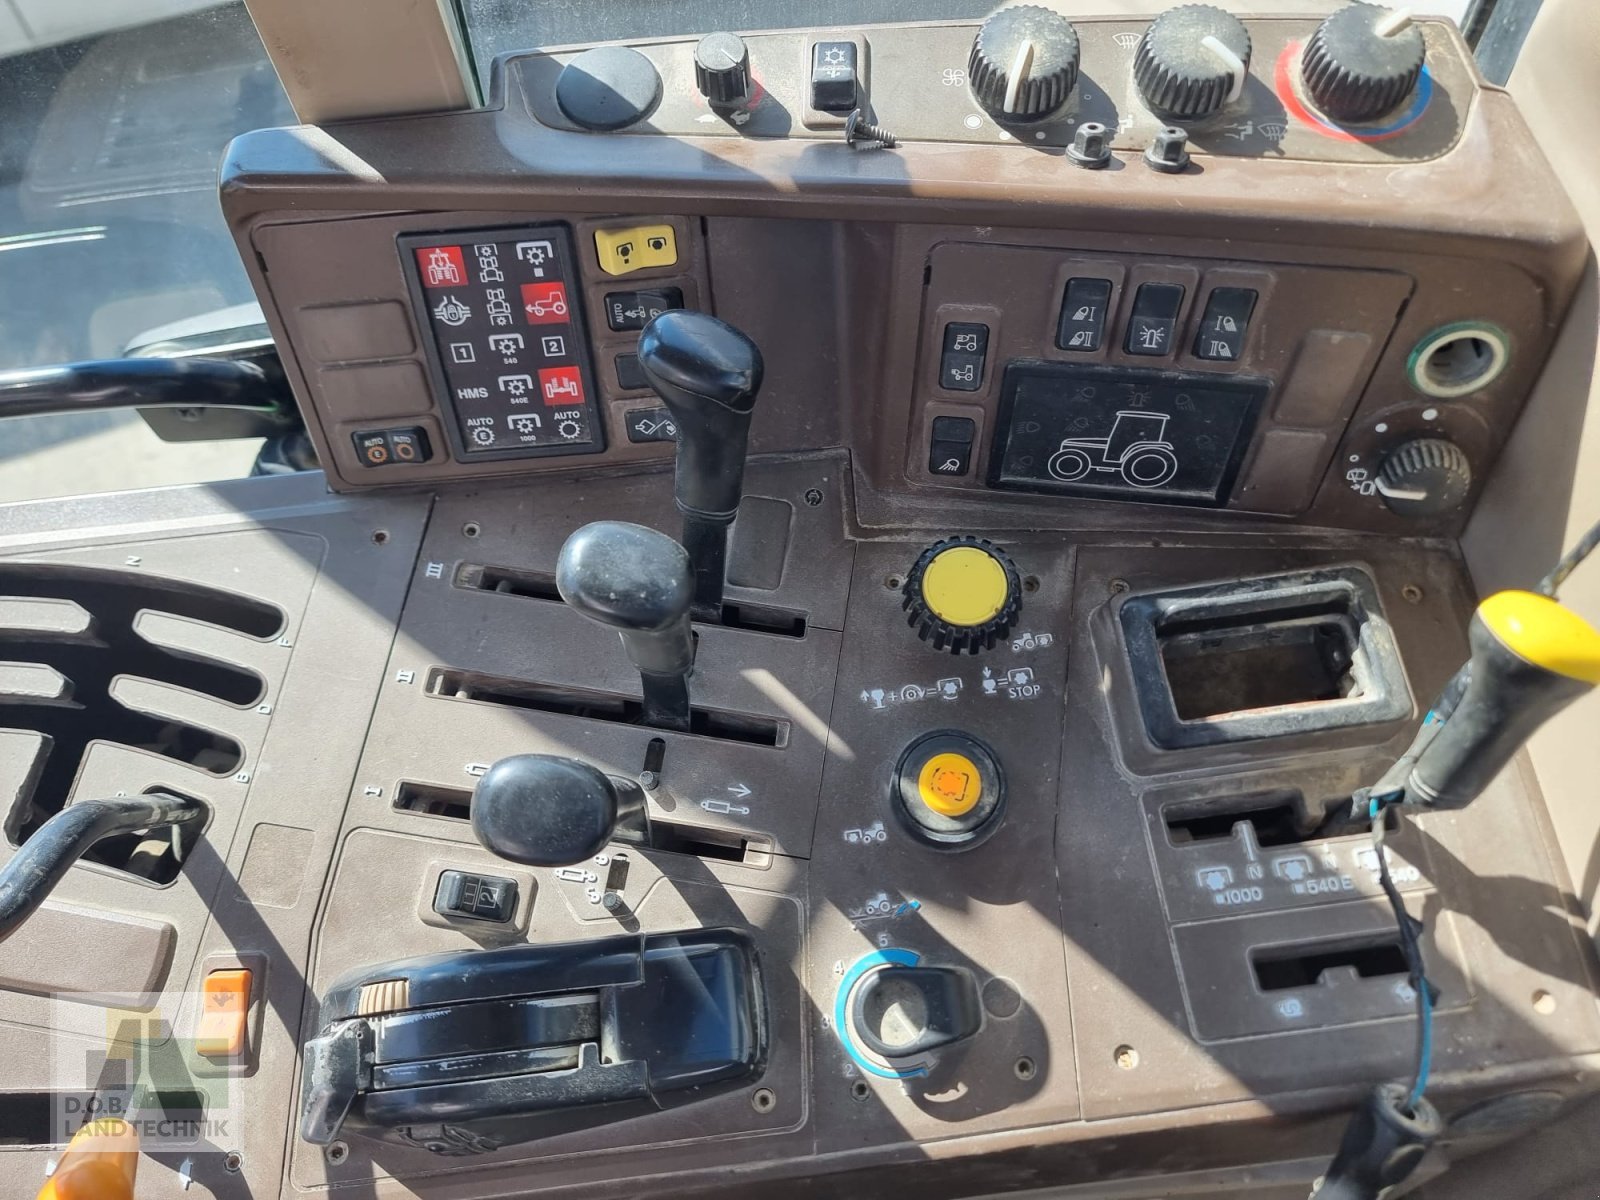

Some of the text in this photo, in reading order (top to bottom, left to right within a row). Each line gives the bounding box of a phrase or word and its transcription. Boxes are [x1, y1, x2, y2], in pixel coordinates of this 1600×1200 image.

[613, 303, 625, 323] AUTO
[457, 387, 489, 399] HMS
[467, 417, 494, 427] AUTO
[554, 411, 580, 420] AUTO
[364, 437, 384, 447] AUTO
[1008, 684, 1040, 698] STOP
[1249, 865, 1264, 880] N
[1226, 887, 1262, 905] 1000
